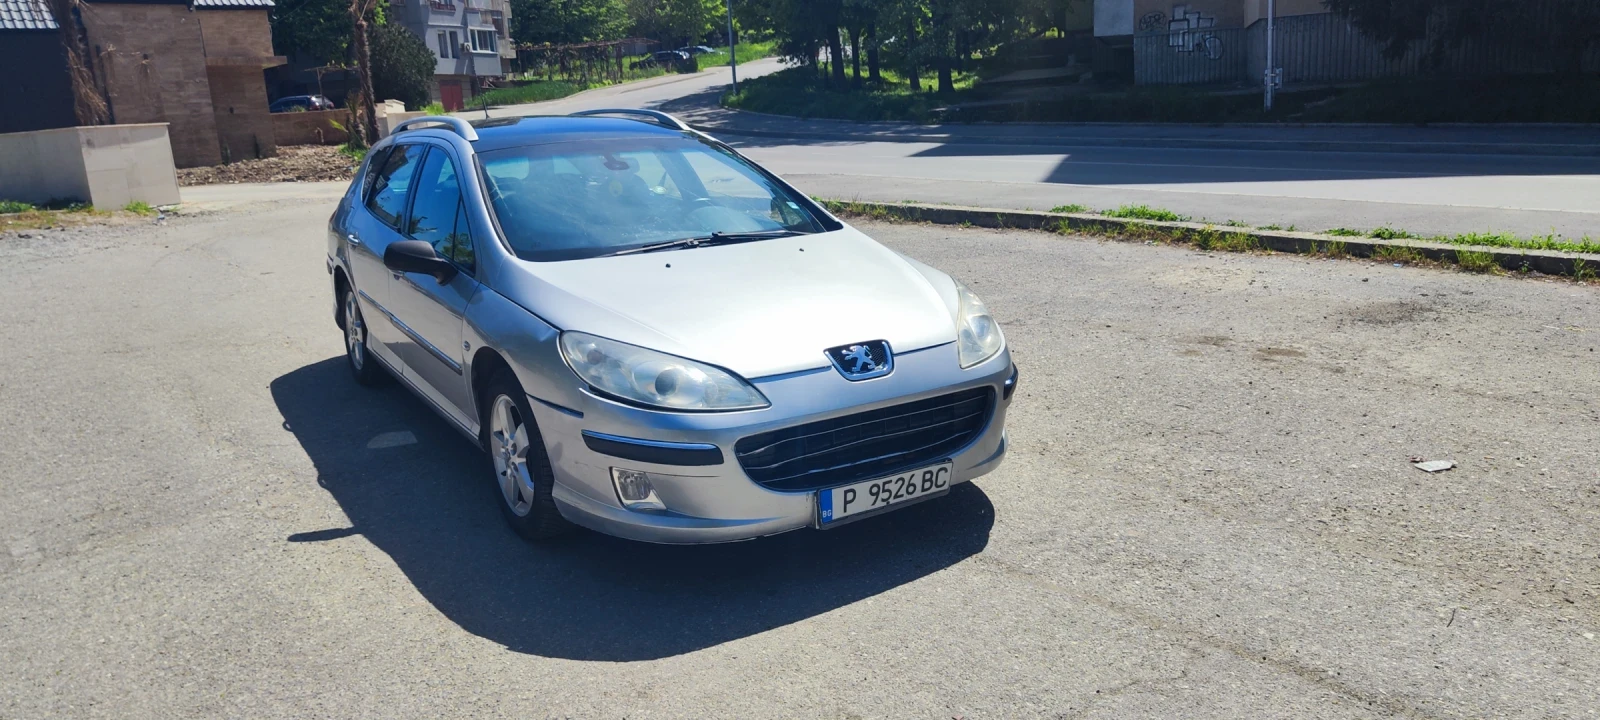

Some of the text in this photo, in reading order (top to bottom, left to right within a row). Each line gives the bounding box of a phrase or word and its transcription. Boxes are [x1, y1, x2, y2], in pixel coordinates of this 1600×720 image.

[843, 467, 949, 513] P 9526 BC
[822, 509, 832, 518] BG
